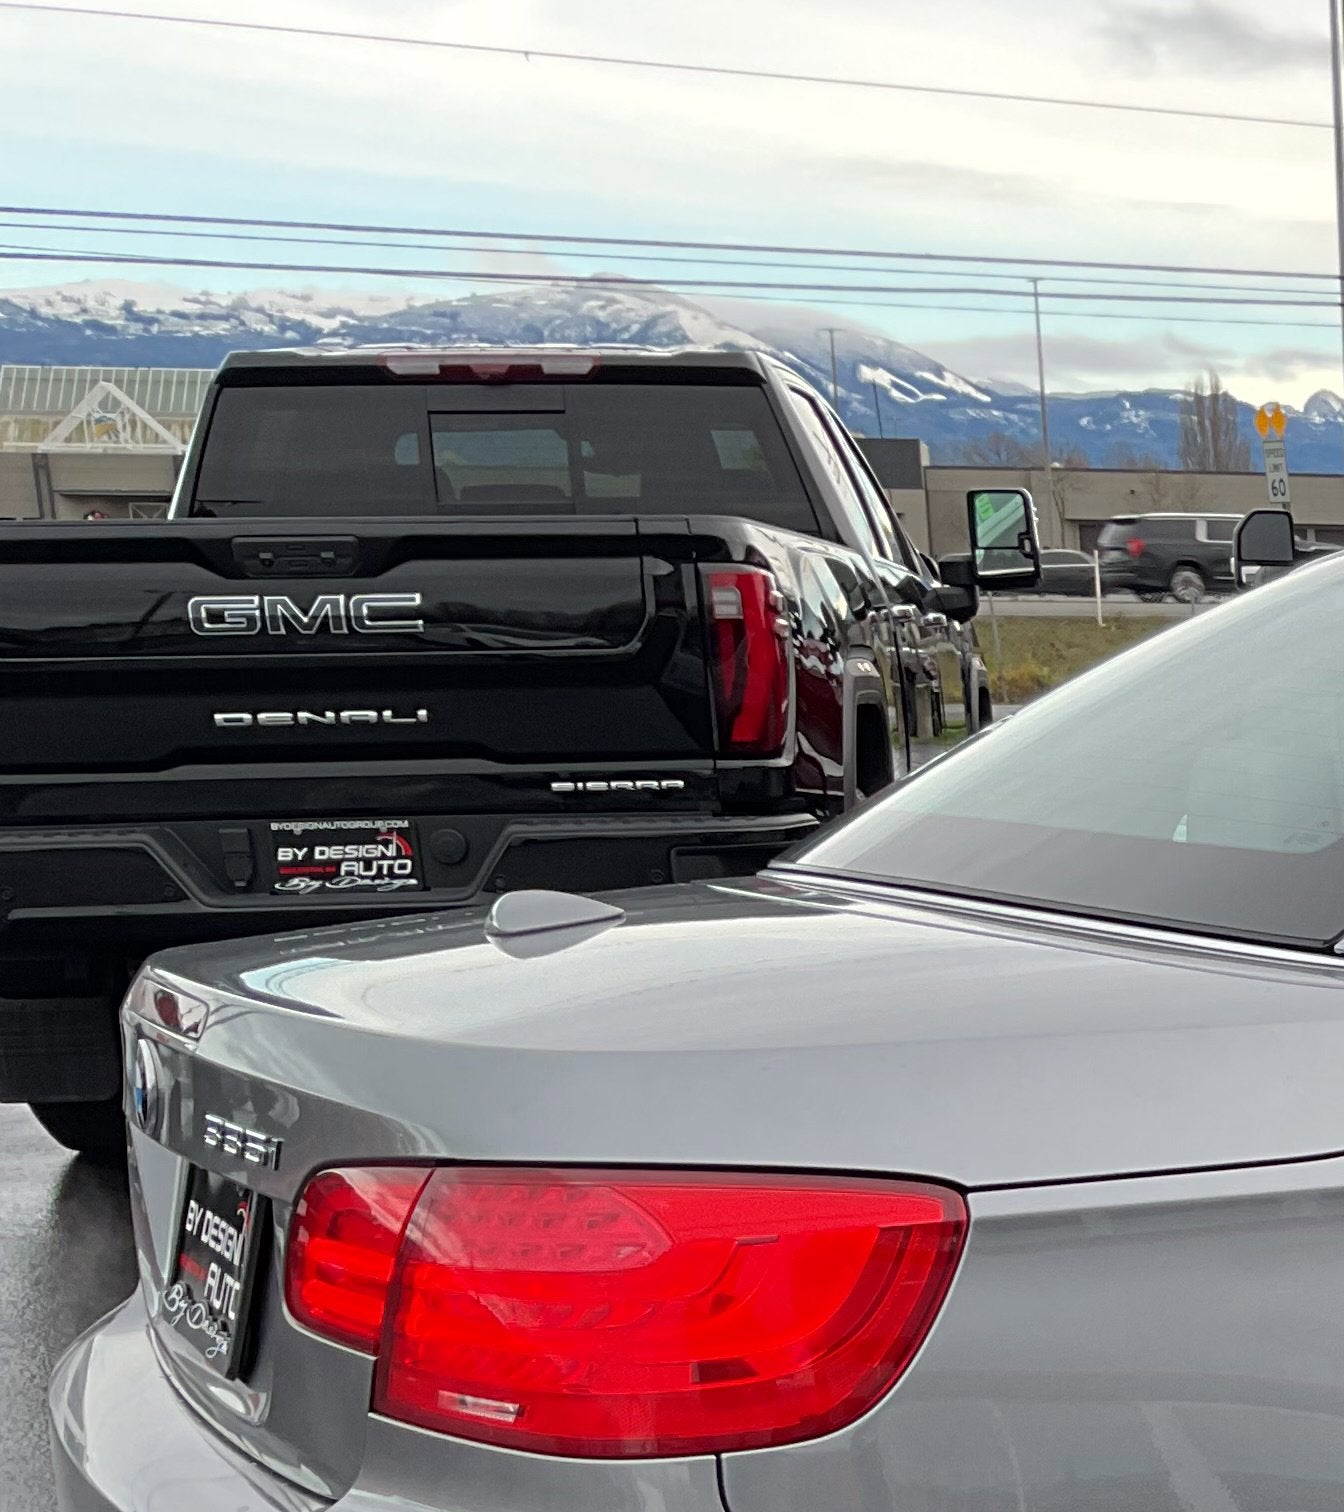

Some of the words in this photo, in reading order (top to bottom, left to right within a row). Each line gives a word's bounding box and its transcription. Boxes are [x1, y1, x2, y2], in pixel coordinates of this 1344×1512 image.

[1271, 478, 1287, 497] 60
[187, 593, 425, 636] GMC
[213, 708, 428, 727] DENALI
[551, 780, 685, 791] SIERRA
[277, 847, 308, 861] BY
[314, 843, 397, 860] DESIGN
[340, 859, 412, 876] AUTO
[185, 1199, 204, 1236] BY
[200, 1209, 245, 1266] DESIGN
